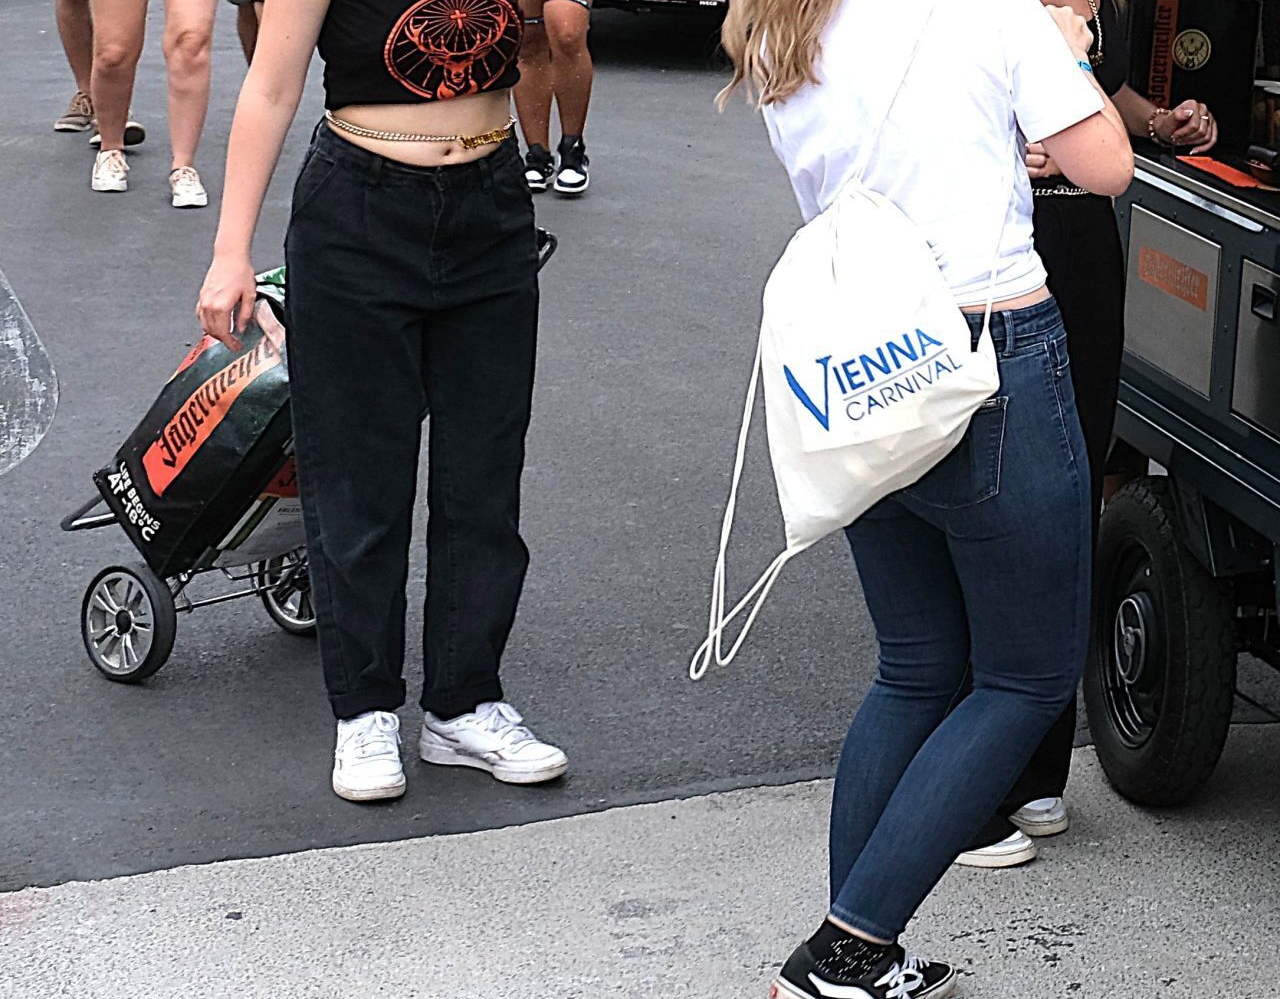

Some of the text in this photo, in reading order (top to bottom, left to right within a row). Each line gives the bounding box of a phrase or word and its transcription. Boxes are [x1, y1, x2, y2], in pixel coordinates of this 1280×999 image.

[782, 327, 944, 433] VIENNA
[844, 353, 964, 422] CARNIVAL
[107, 472, 125, 496] AT
[119, 460, 161, 531] LIFE BEGINS
